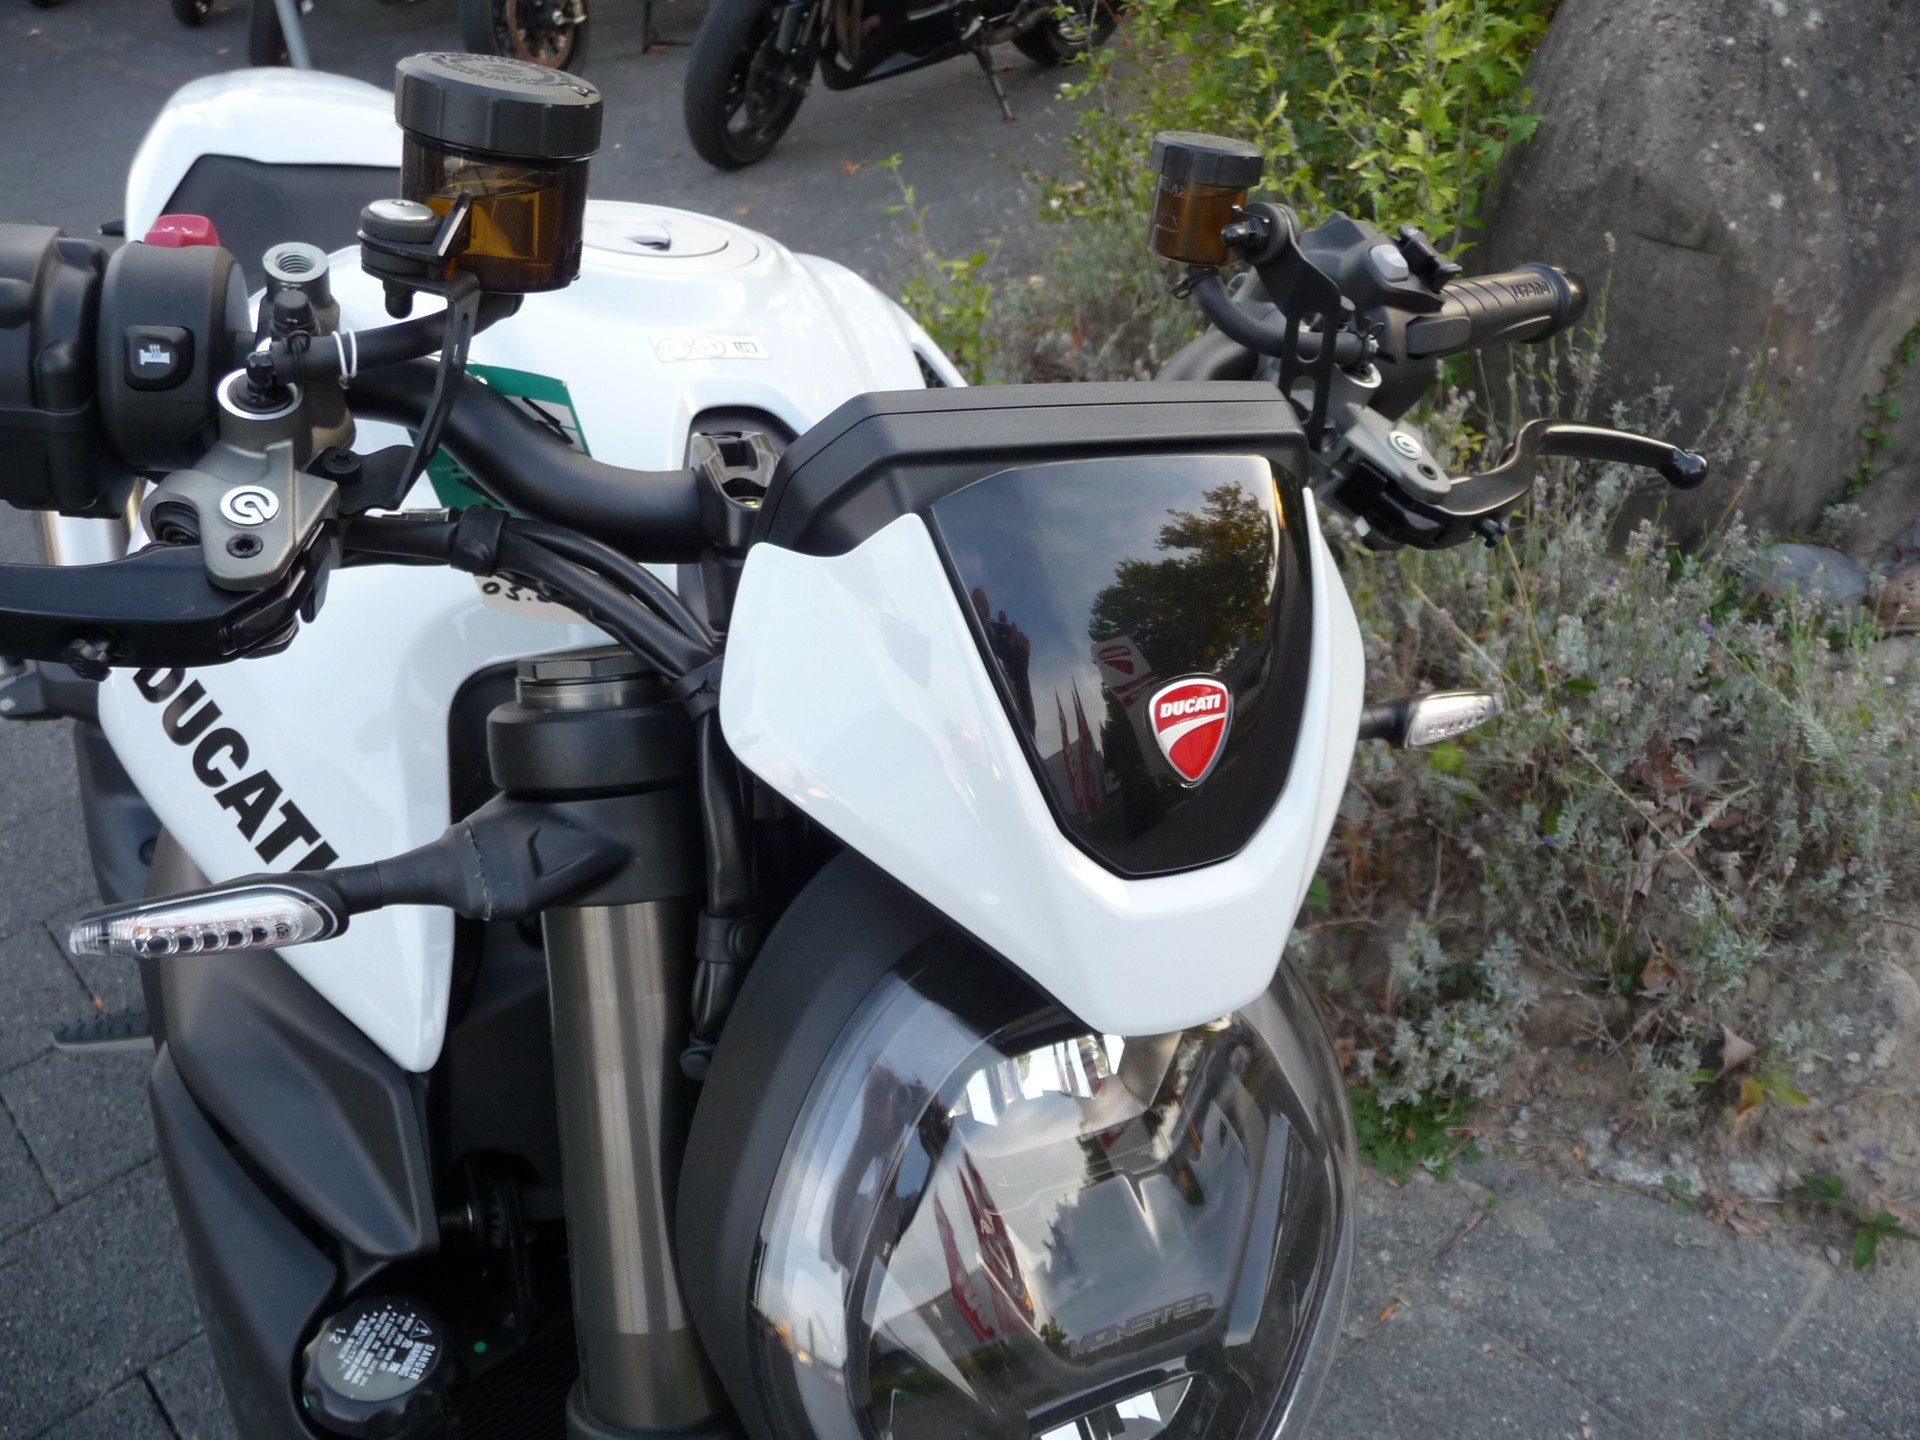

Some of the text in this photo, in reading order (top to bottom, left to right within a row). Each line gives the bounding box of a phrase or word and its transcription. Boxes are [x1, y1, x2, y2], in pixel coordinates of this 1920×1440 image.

[1160, 694, 1221, 718] DUCATI
[1068, 1292, 1215, 1359] MONSTER
[398, 1342, 426, 1377] WARNING
[408, 1344, 436, 1380] DANGER
